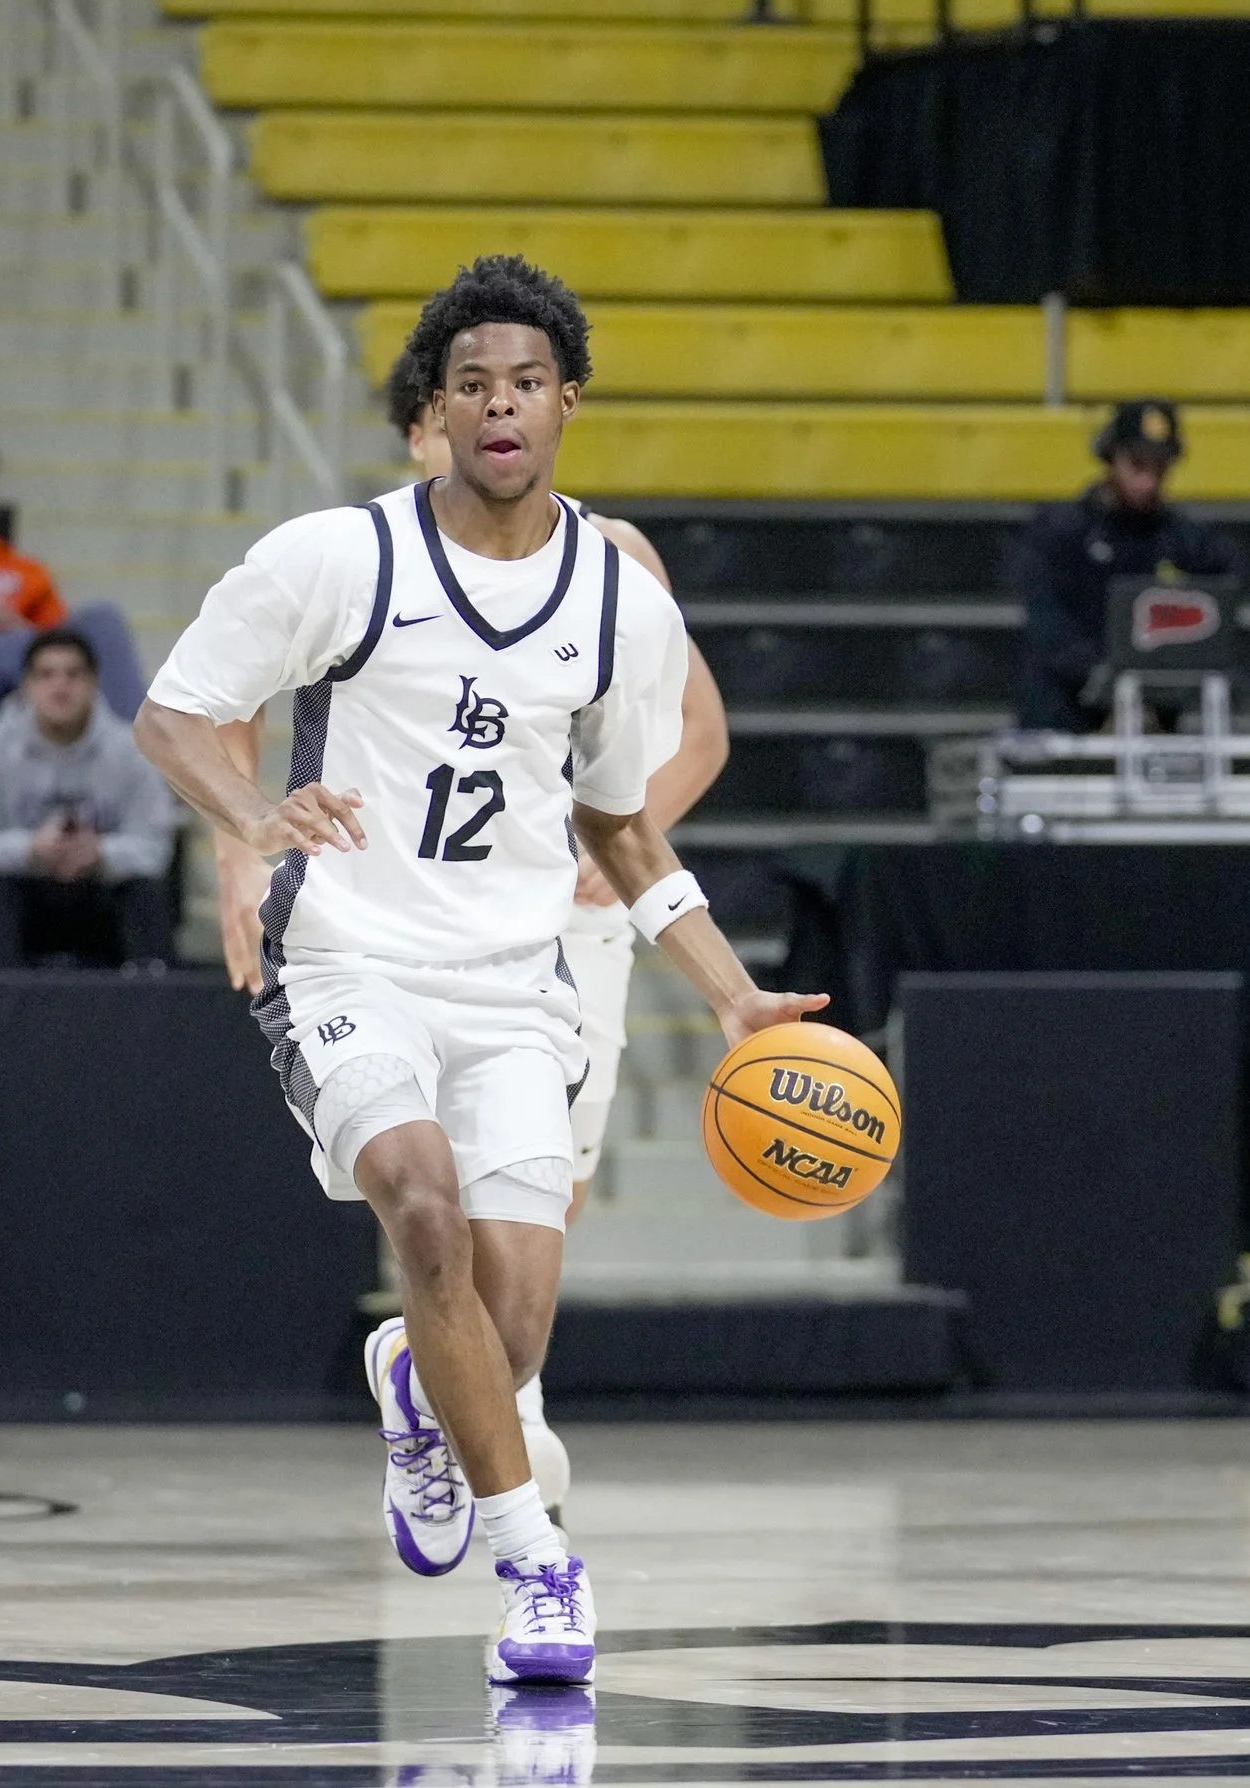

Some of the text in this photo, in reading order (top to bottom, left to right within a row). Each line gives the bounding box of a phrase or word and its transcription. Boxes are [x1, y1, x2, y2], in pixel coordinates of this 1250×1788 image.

[446, 674, 510, 750] LB
[417, 763, 506, 862] 12
[768, 1066, 886, 1145] Wilson
[761, 1137, 855, 1190] NCAA
